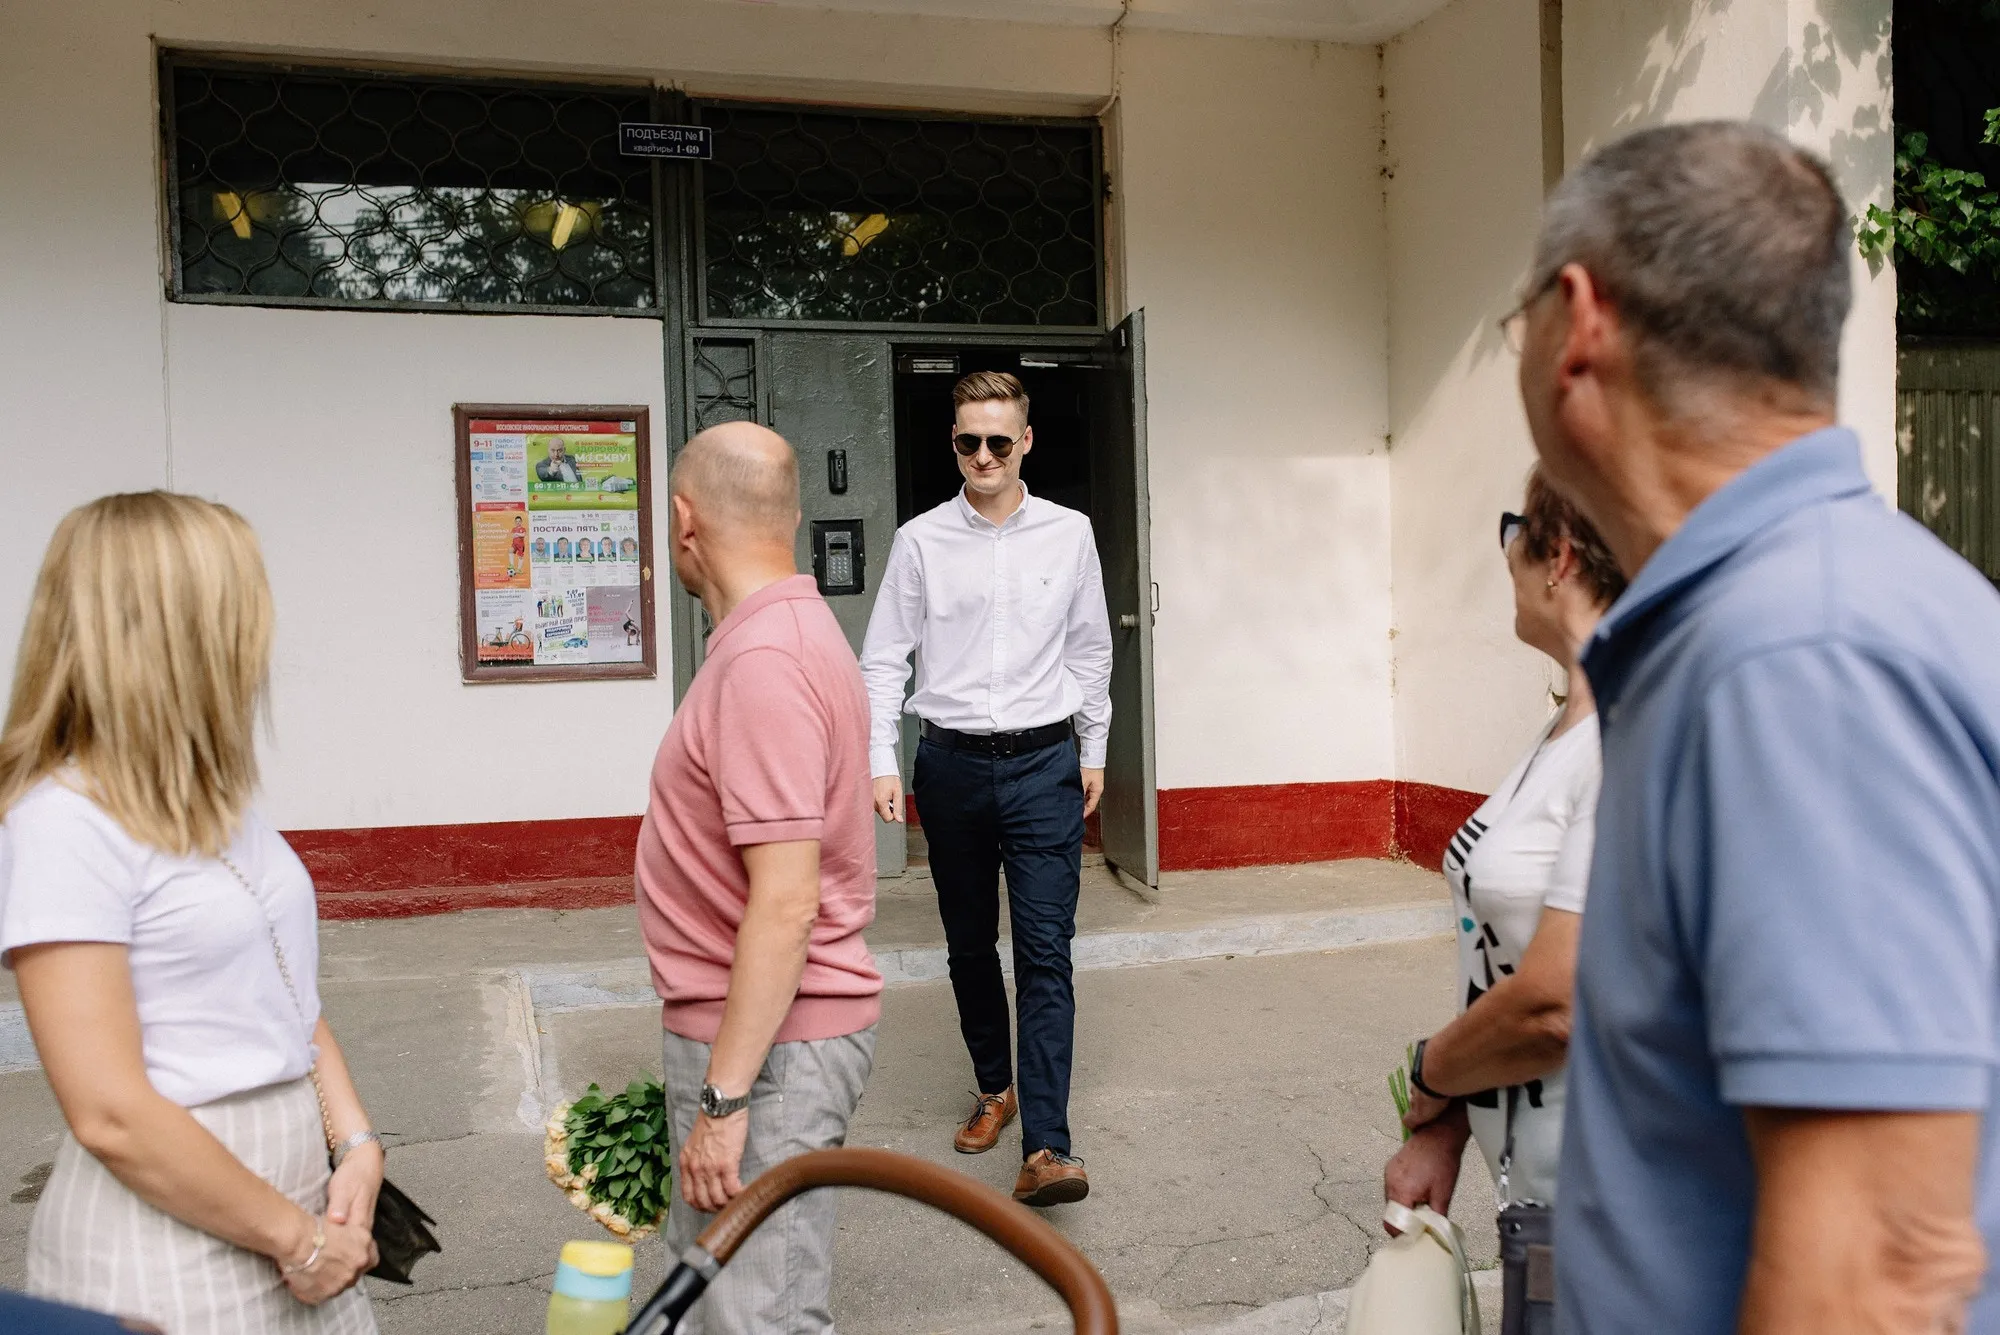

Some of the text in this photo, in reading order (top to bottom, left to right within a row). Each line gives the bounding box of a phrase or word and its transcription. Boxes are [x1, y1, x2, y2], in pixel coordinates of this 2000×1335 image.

[626, 128, 682, 141] ПОДЪЕЗД
[633, 144, 700, 154] квартиры 1-69
